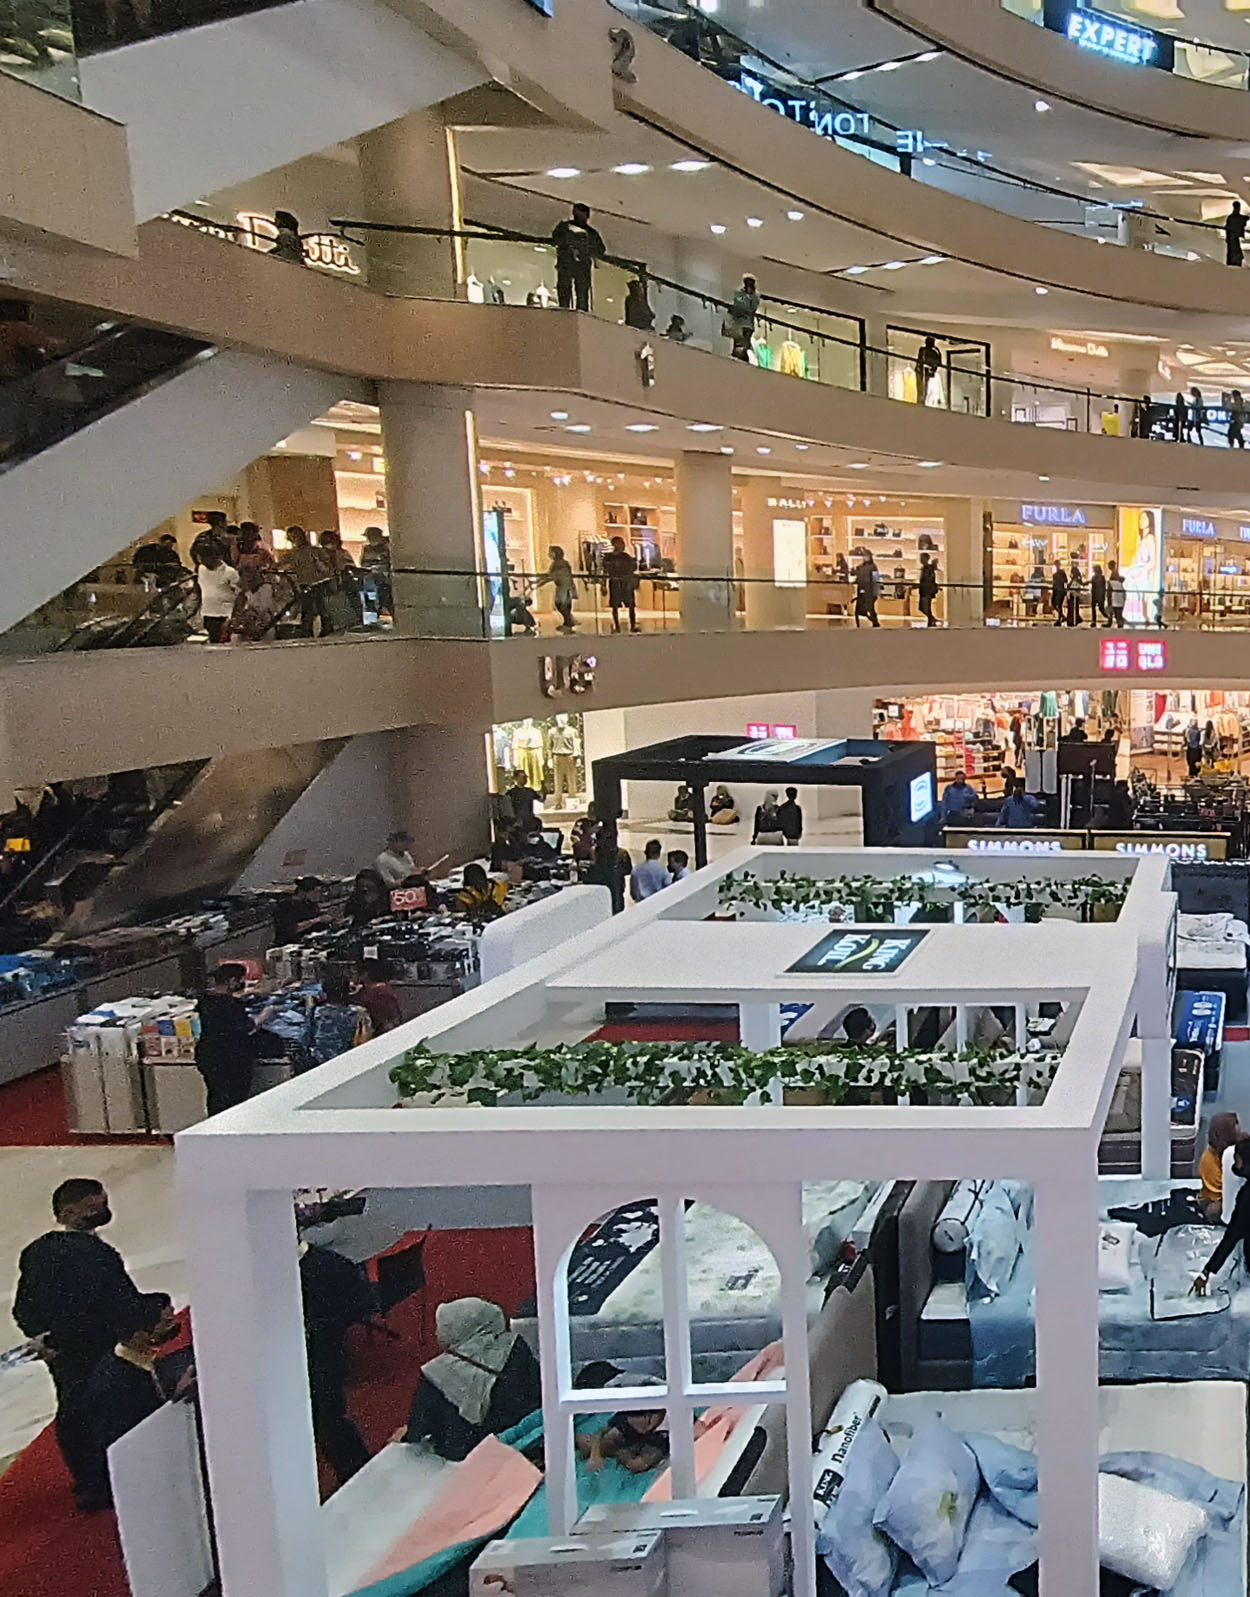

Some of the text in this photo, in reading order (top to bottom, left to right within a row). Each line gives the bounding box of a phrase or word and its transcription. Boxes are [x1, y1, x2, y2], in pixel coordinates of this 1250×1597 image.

[1068, 12, 1156, 64] EXPERT
[1021, 504, 1087, 524] FURLA
[1182, 518, 1215, 536] FURLA
[1115, 842, 1208, 858] SIMMONS
[816, 933, 872, 966] KOIL
[862, 938, 912, 970] KING
